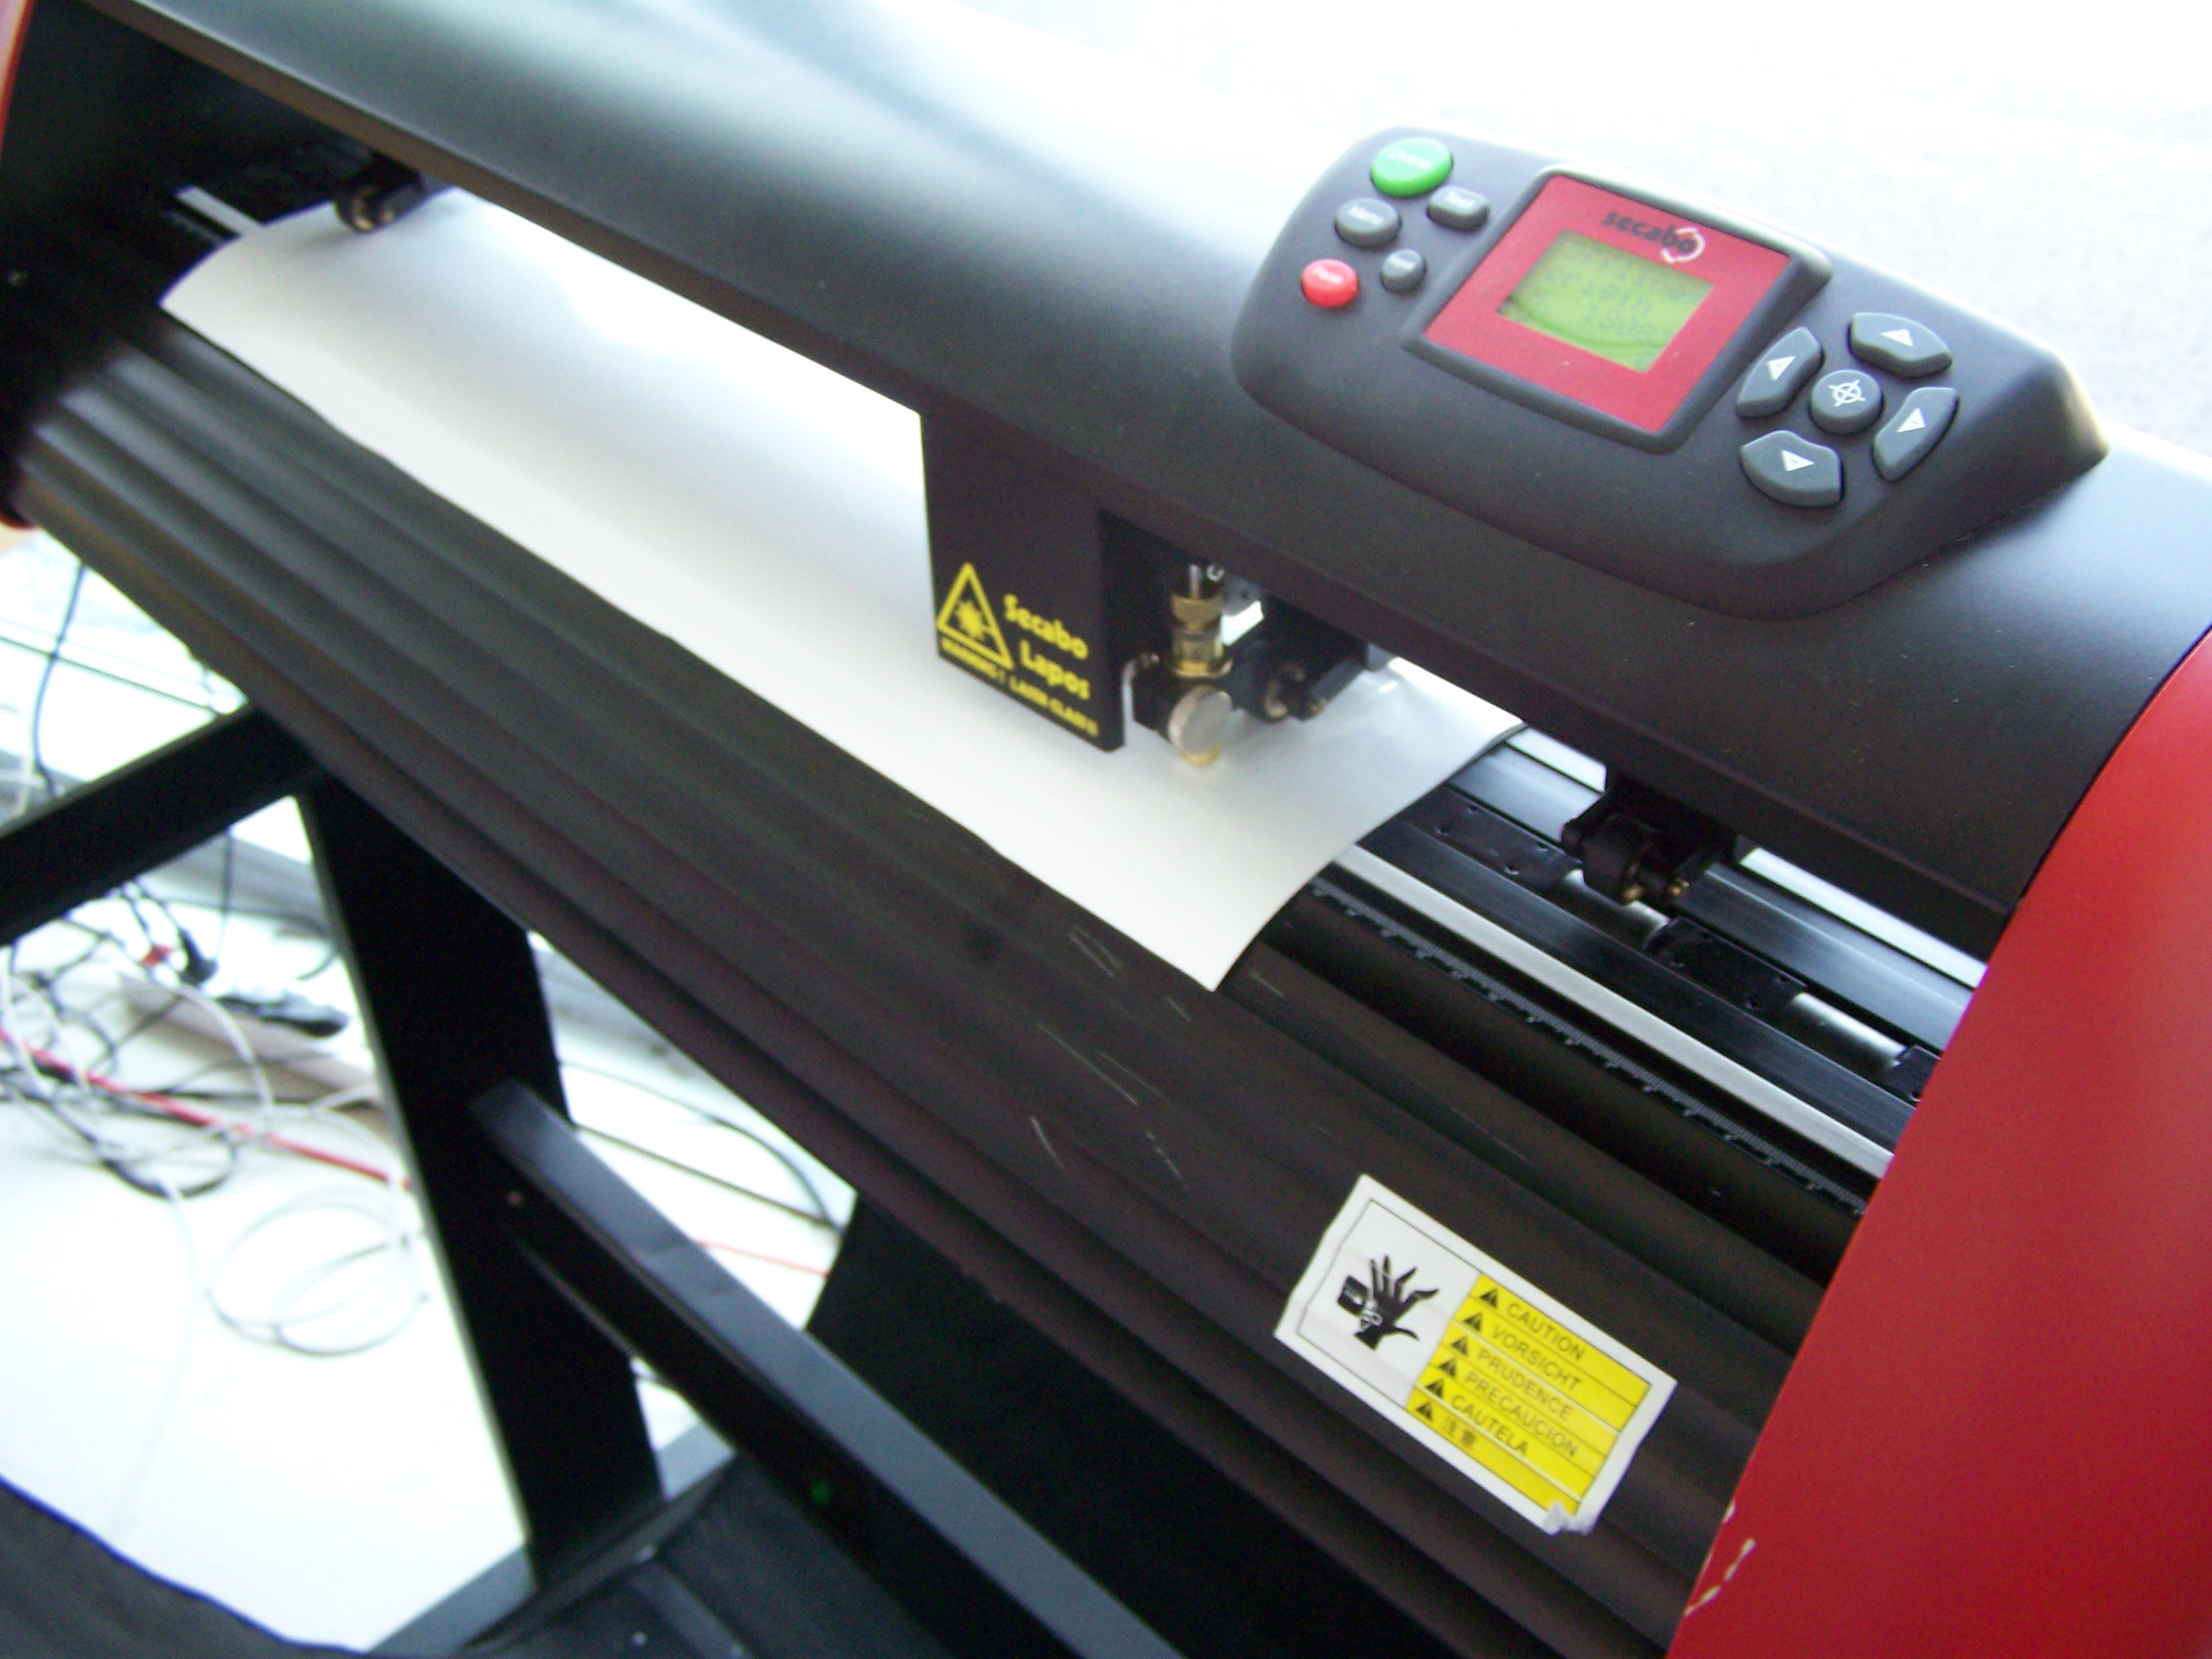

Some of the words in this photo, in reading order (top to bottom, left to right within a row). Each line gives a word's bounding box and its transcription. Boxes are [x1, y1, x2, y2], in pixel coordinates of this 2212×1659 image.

[1601, 211, 1698, 253] secabo
[1003, 593, 1089, 660] Secabo
[1019, 639, 1090, 701] Lapos
[1491, 1322, 1583, 1392] VORSICHT
[1506, 1302, 1586, 1362] CAUTION
[1464, 1370, 1581, 1457] PRECAUCION
[1476, 1348, 1575, 1423] PRUDENCE
[1451, 1394, 1529, 1456] CAUTELA
